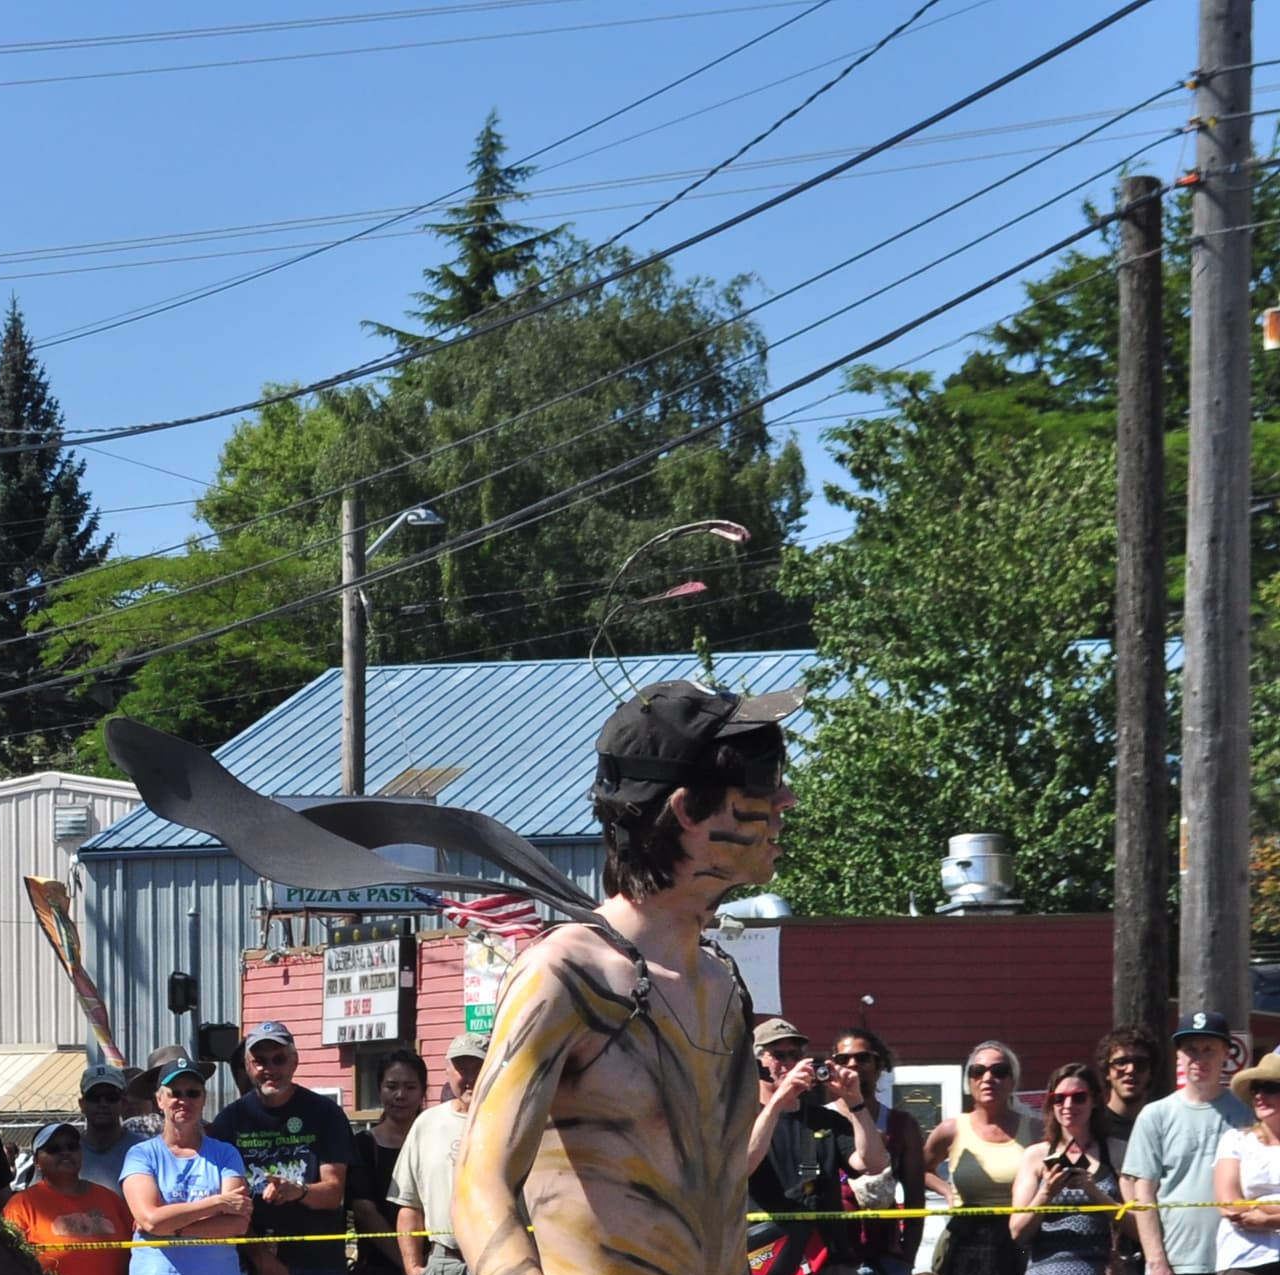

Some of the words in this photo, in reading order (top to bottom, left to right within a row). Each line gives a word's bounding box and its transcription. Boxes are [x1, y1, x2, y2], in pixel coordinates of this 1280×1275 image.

[286, 887, 342, 902] PIZZA
[347, 889, 361, 902] &
[236, 1137, 272, 1148] Century
[275, 1134, 316, 1146] Challenge
